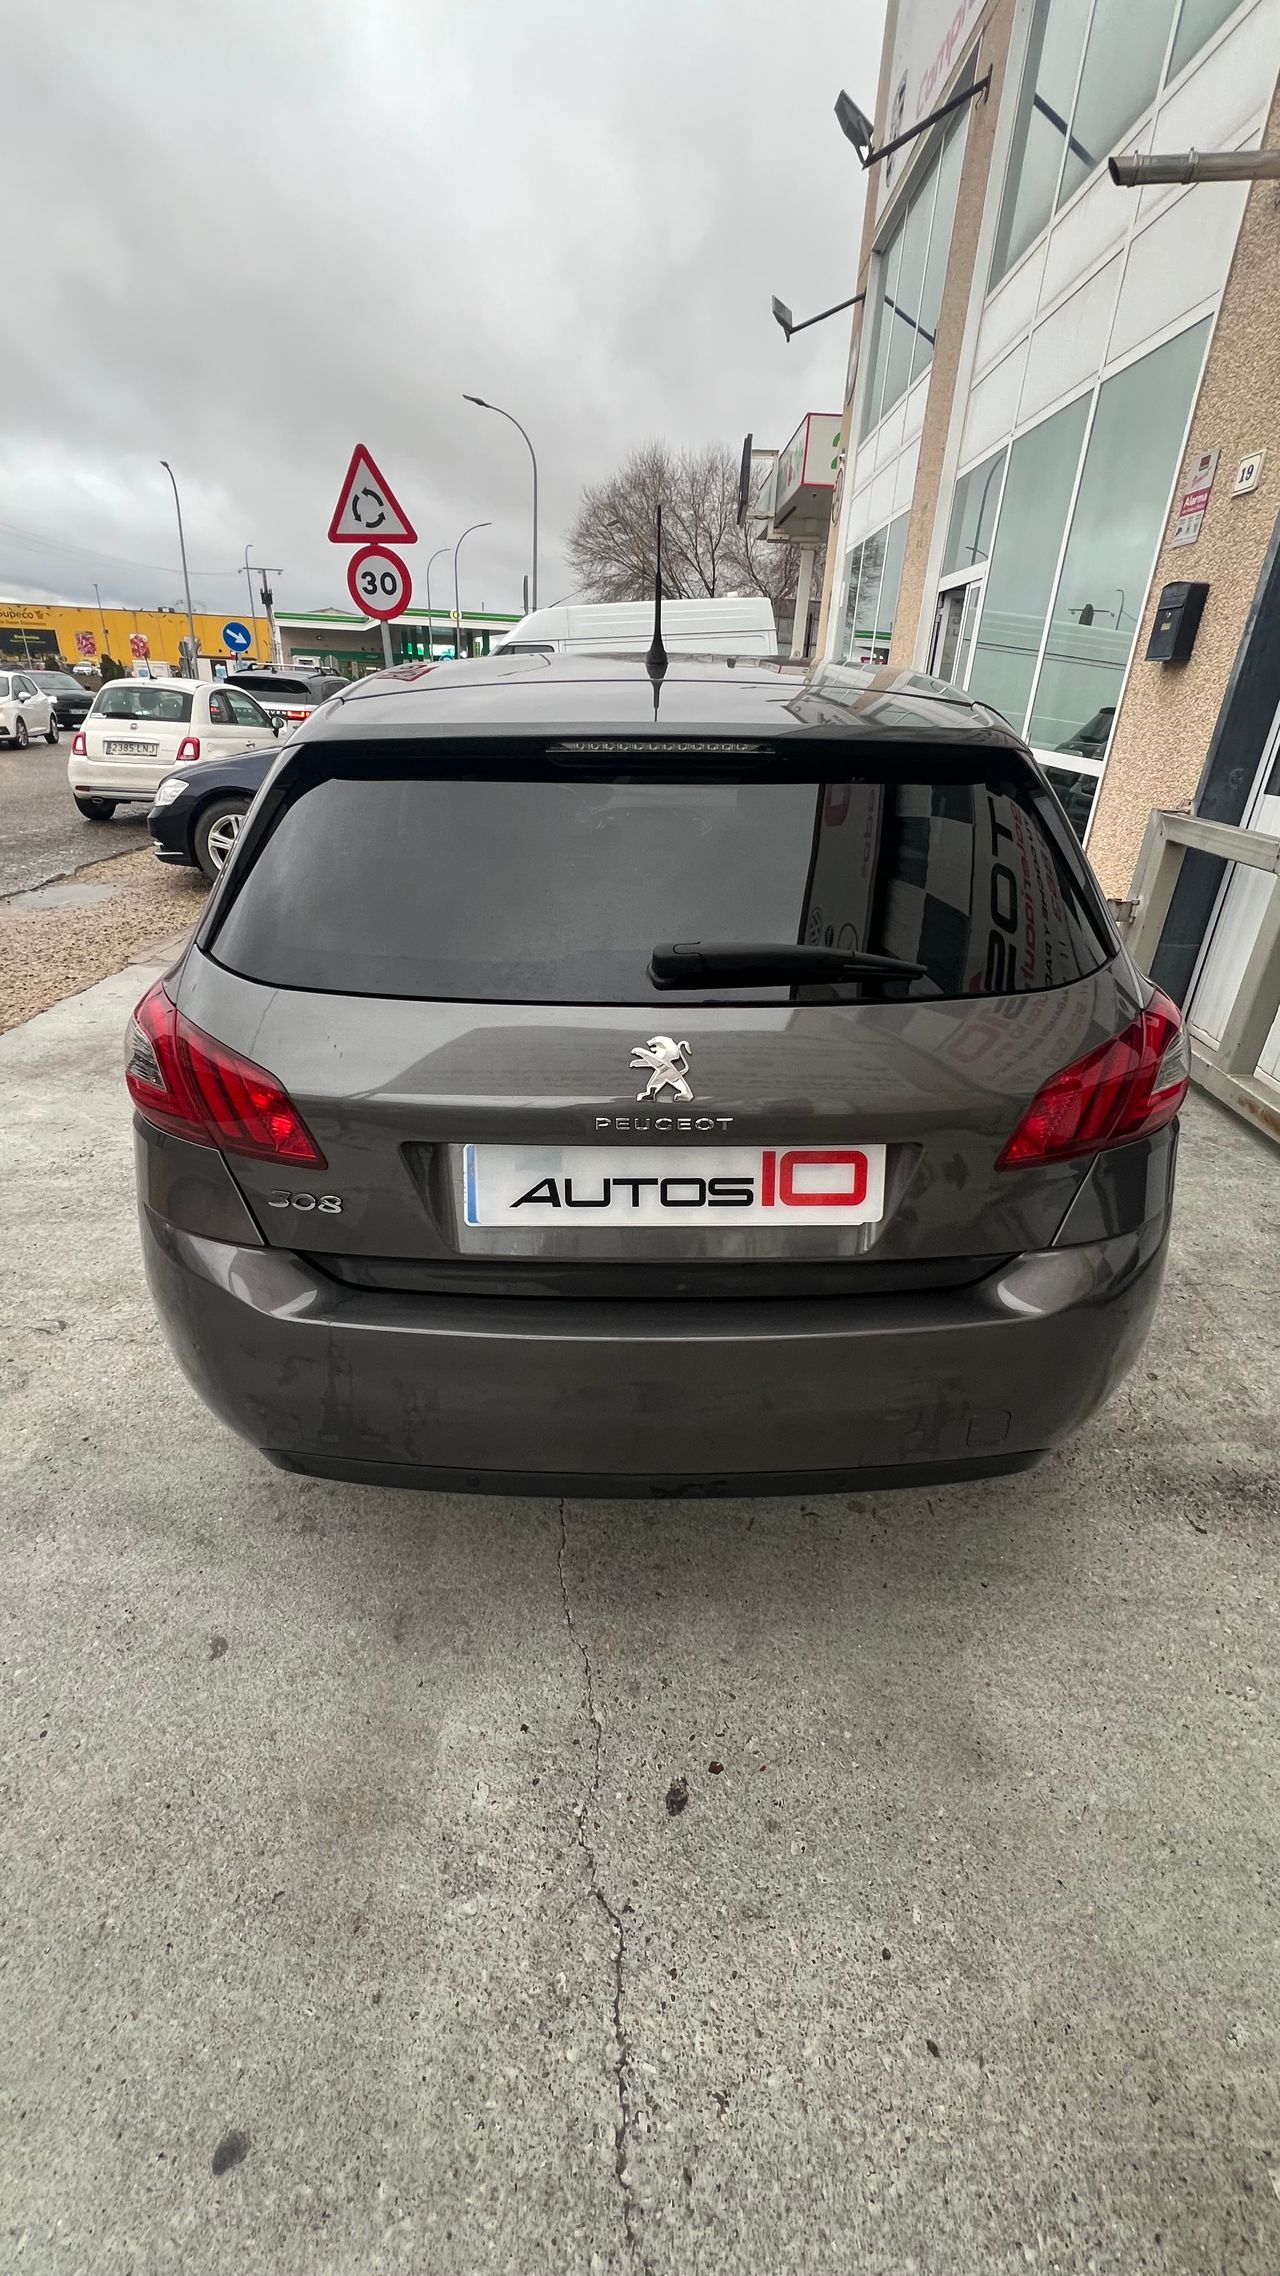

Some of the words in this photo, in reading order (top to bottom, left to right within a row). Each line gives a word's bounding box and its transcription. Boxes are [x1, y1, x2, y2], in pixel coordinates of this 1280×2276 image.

[1238, 465, 1254, 482] 19
[1183, 493, 1207, 506] Alarma
[361, 571, 398, 596] 30
[112, 743, 134, 753] 2385
[137, 744, 155, 753] LNJ
[594, 1116, 735, 1132] PEUGEOT
[267, 1189, 344, 1214] 308
